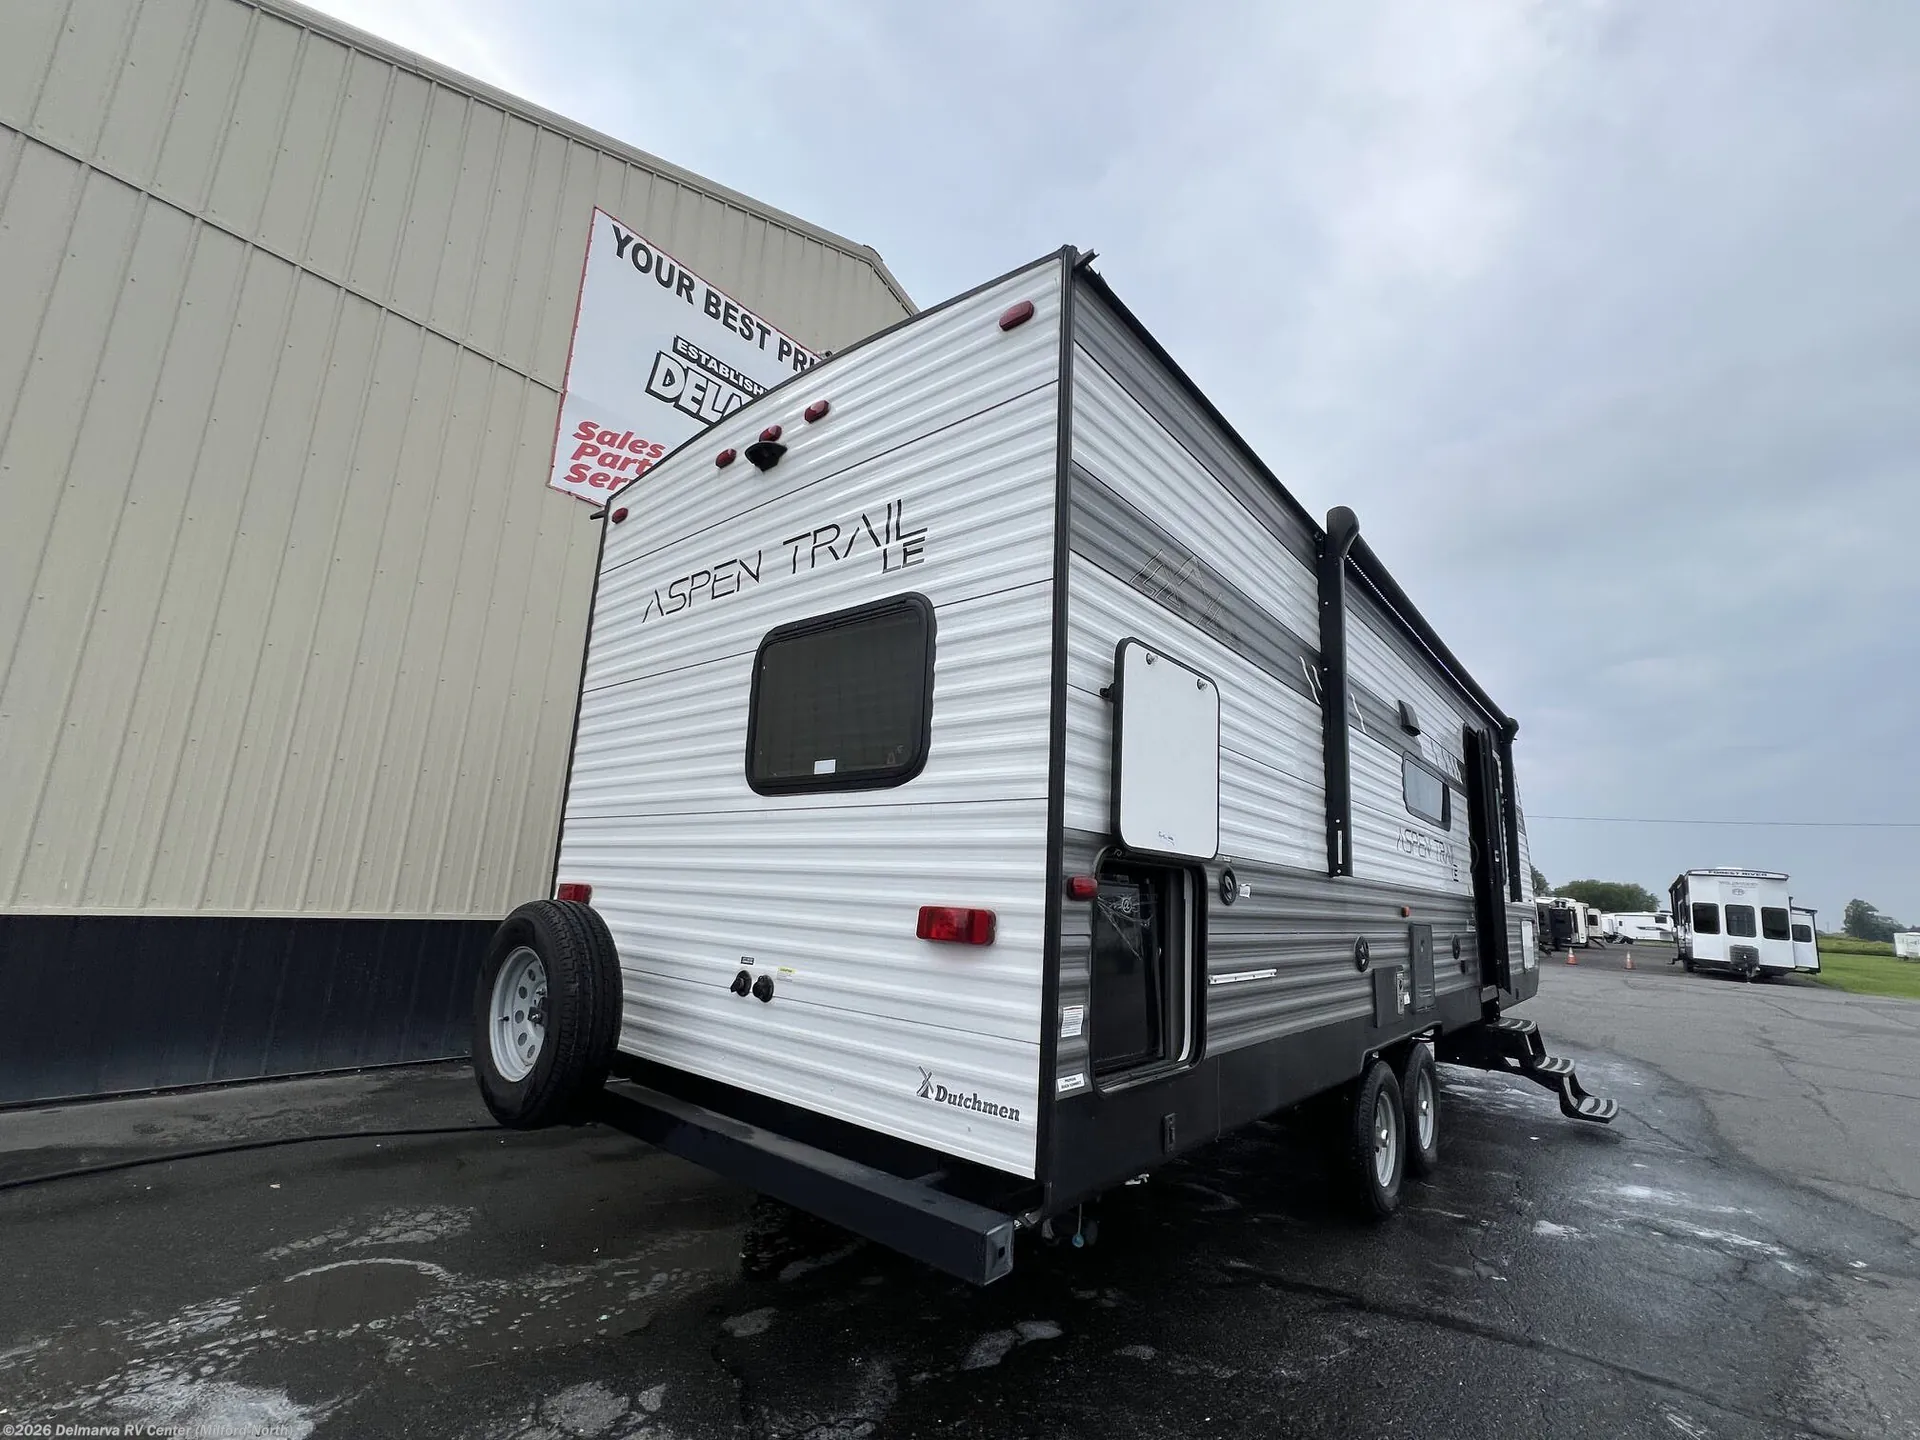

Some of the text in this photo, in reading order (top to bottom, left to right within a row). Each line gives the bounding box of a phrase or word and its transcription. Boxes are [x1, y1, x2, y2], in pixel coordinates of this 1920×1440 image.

[612, 224, 695, 305] YOUR
[704, 288, 772, 350] BEST
[674, 337, 768, 396] ESTABLISH
[572, 421, 666, 458] Sales
[563, 463, 633, 491] Ser
[642, 499, 928, 623] ASPEN TRAIL
[883, 536, 925, 574] LE
[1396, 826, 1431, 859] ASPEN
[935, 1084, 1020, 1121] Dutchmen
